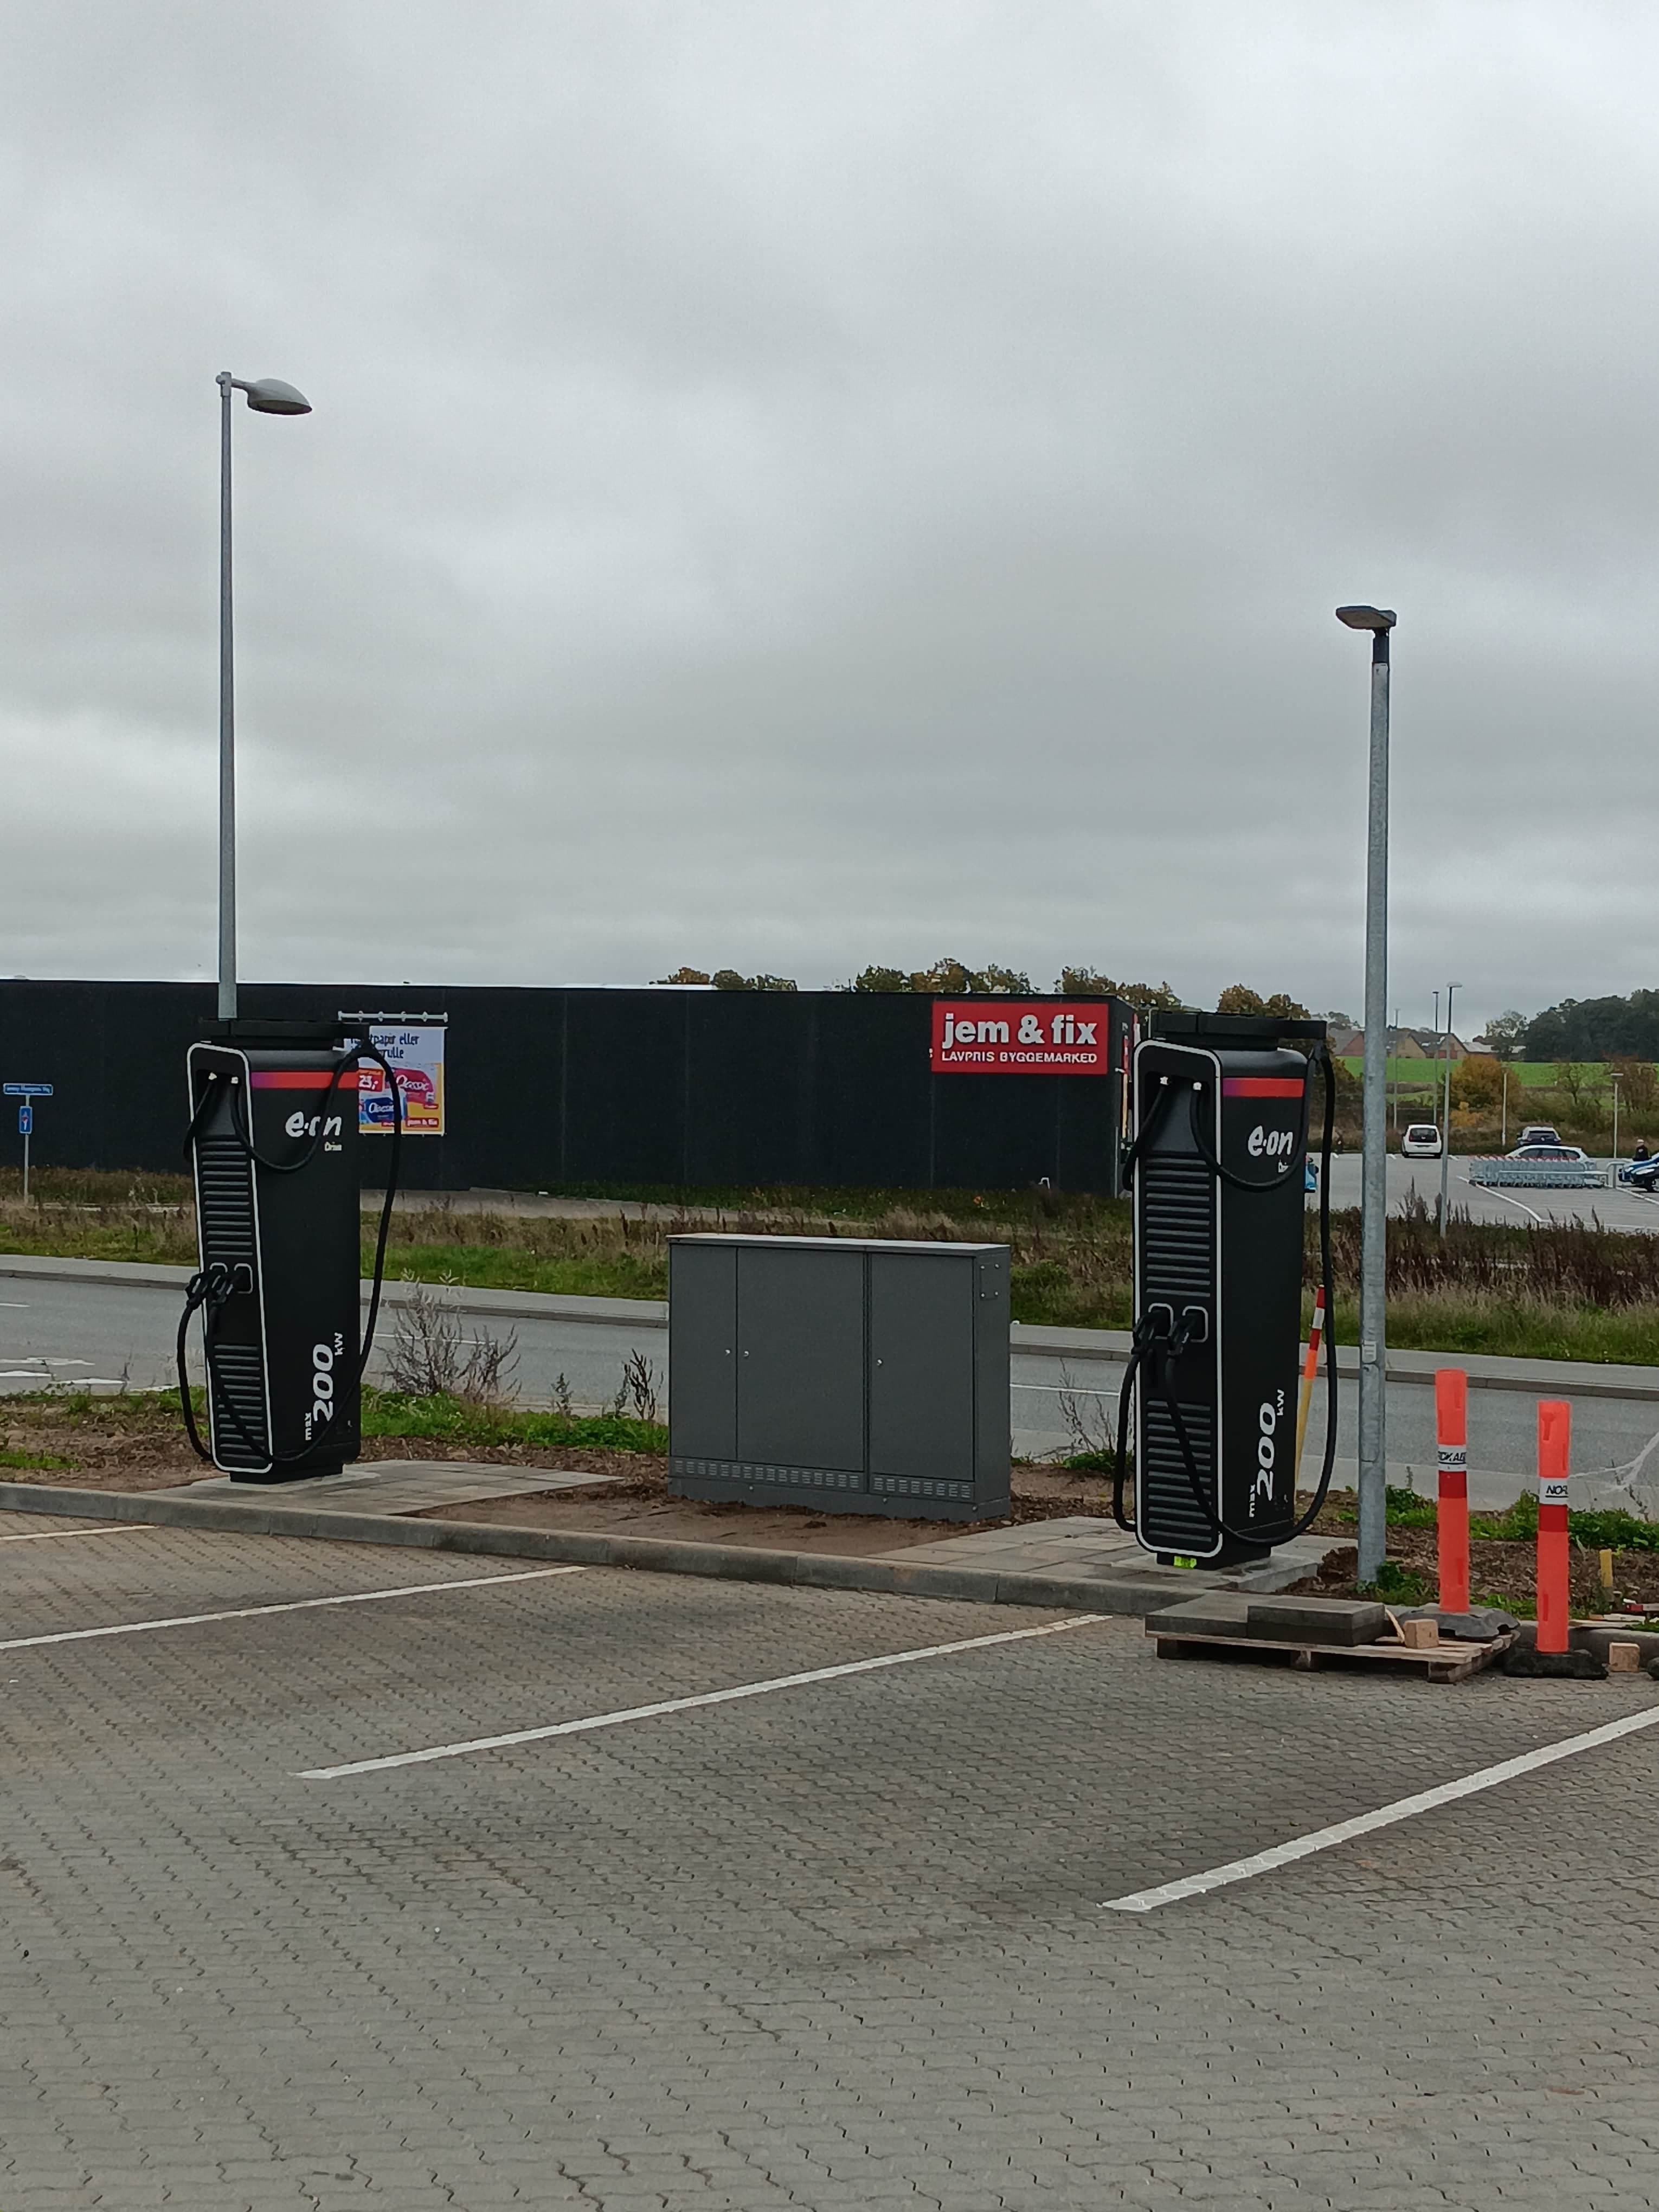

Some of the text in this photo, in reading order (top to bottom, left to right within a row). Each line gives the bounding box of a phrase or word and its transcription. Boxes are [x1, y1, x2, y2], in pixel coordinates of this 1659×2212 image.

[942, 1013, 1097, 1049] jem & fix
[942, 1051, 1097, 1063] LAVPRIS BYGGEMARKED
[313, 1344, 333, 1422] 200
[1257, 1403, 1275, 1501] 200
